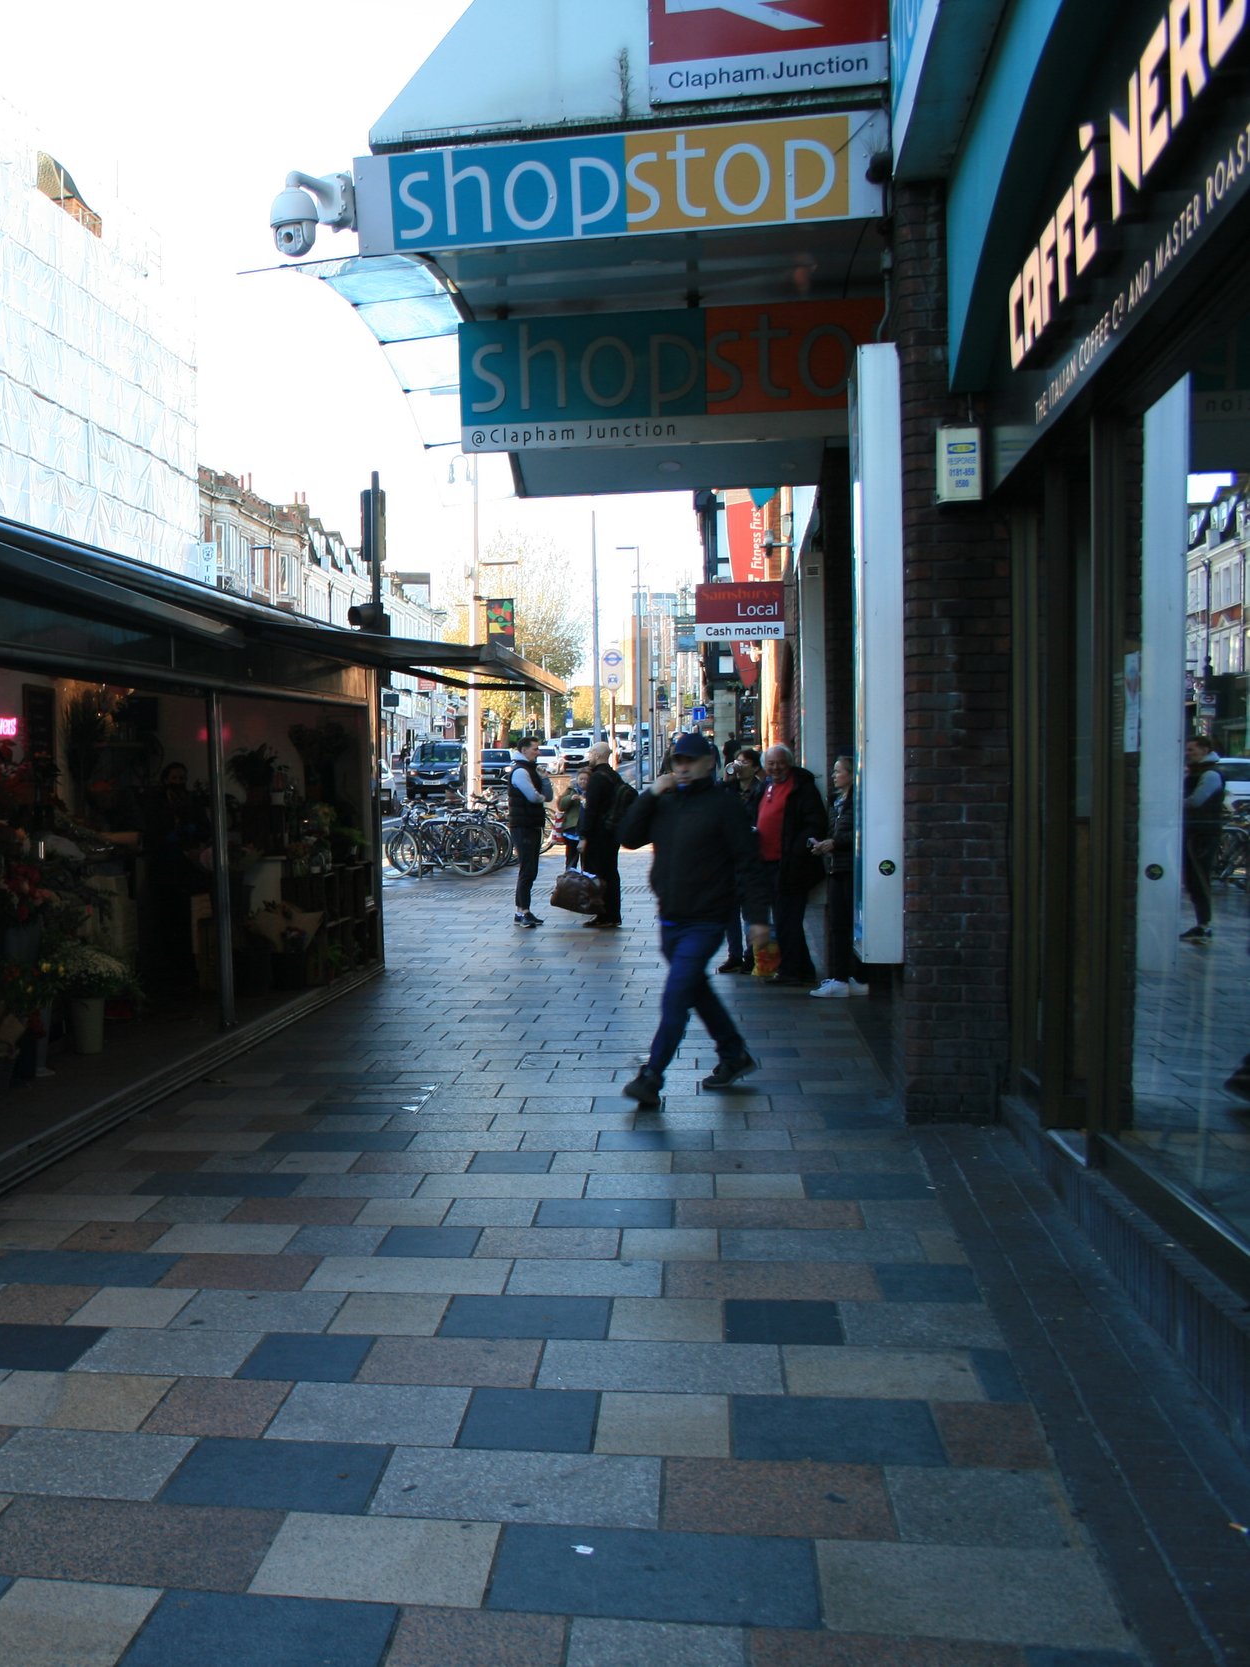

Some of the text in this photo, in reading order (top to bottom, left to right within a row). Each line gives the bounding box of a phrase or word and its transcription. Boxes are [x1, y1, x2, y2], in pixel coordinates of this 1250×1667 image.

[668, 56, 869, 90] Clapham Junction
[1008, 121, 1098, 371] CAFFÉ
[1034, 391, 1048, 425] THE
[1049, 355, 1079, 408] ITALIAN
[1078, 310, 1110, 372] COFFEE
[1127, 260, 1151, 312] AND
[1154, 195, 1201, 280] MASTER
[471, 312, 850, 418] shopsto
[586, 420, 677, 441] Junction
[701, 587, 780, 602] Sainsbury's
[737, 602, 778, 617] Local
[705, 625, 779, 637] Cash machine
